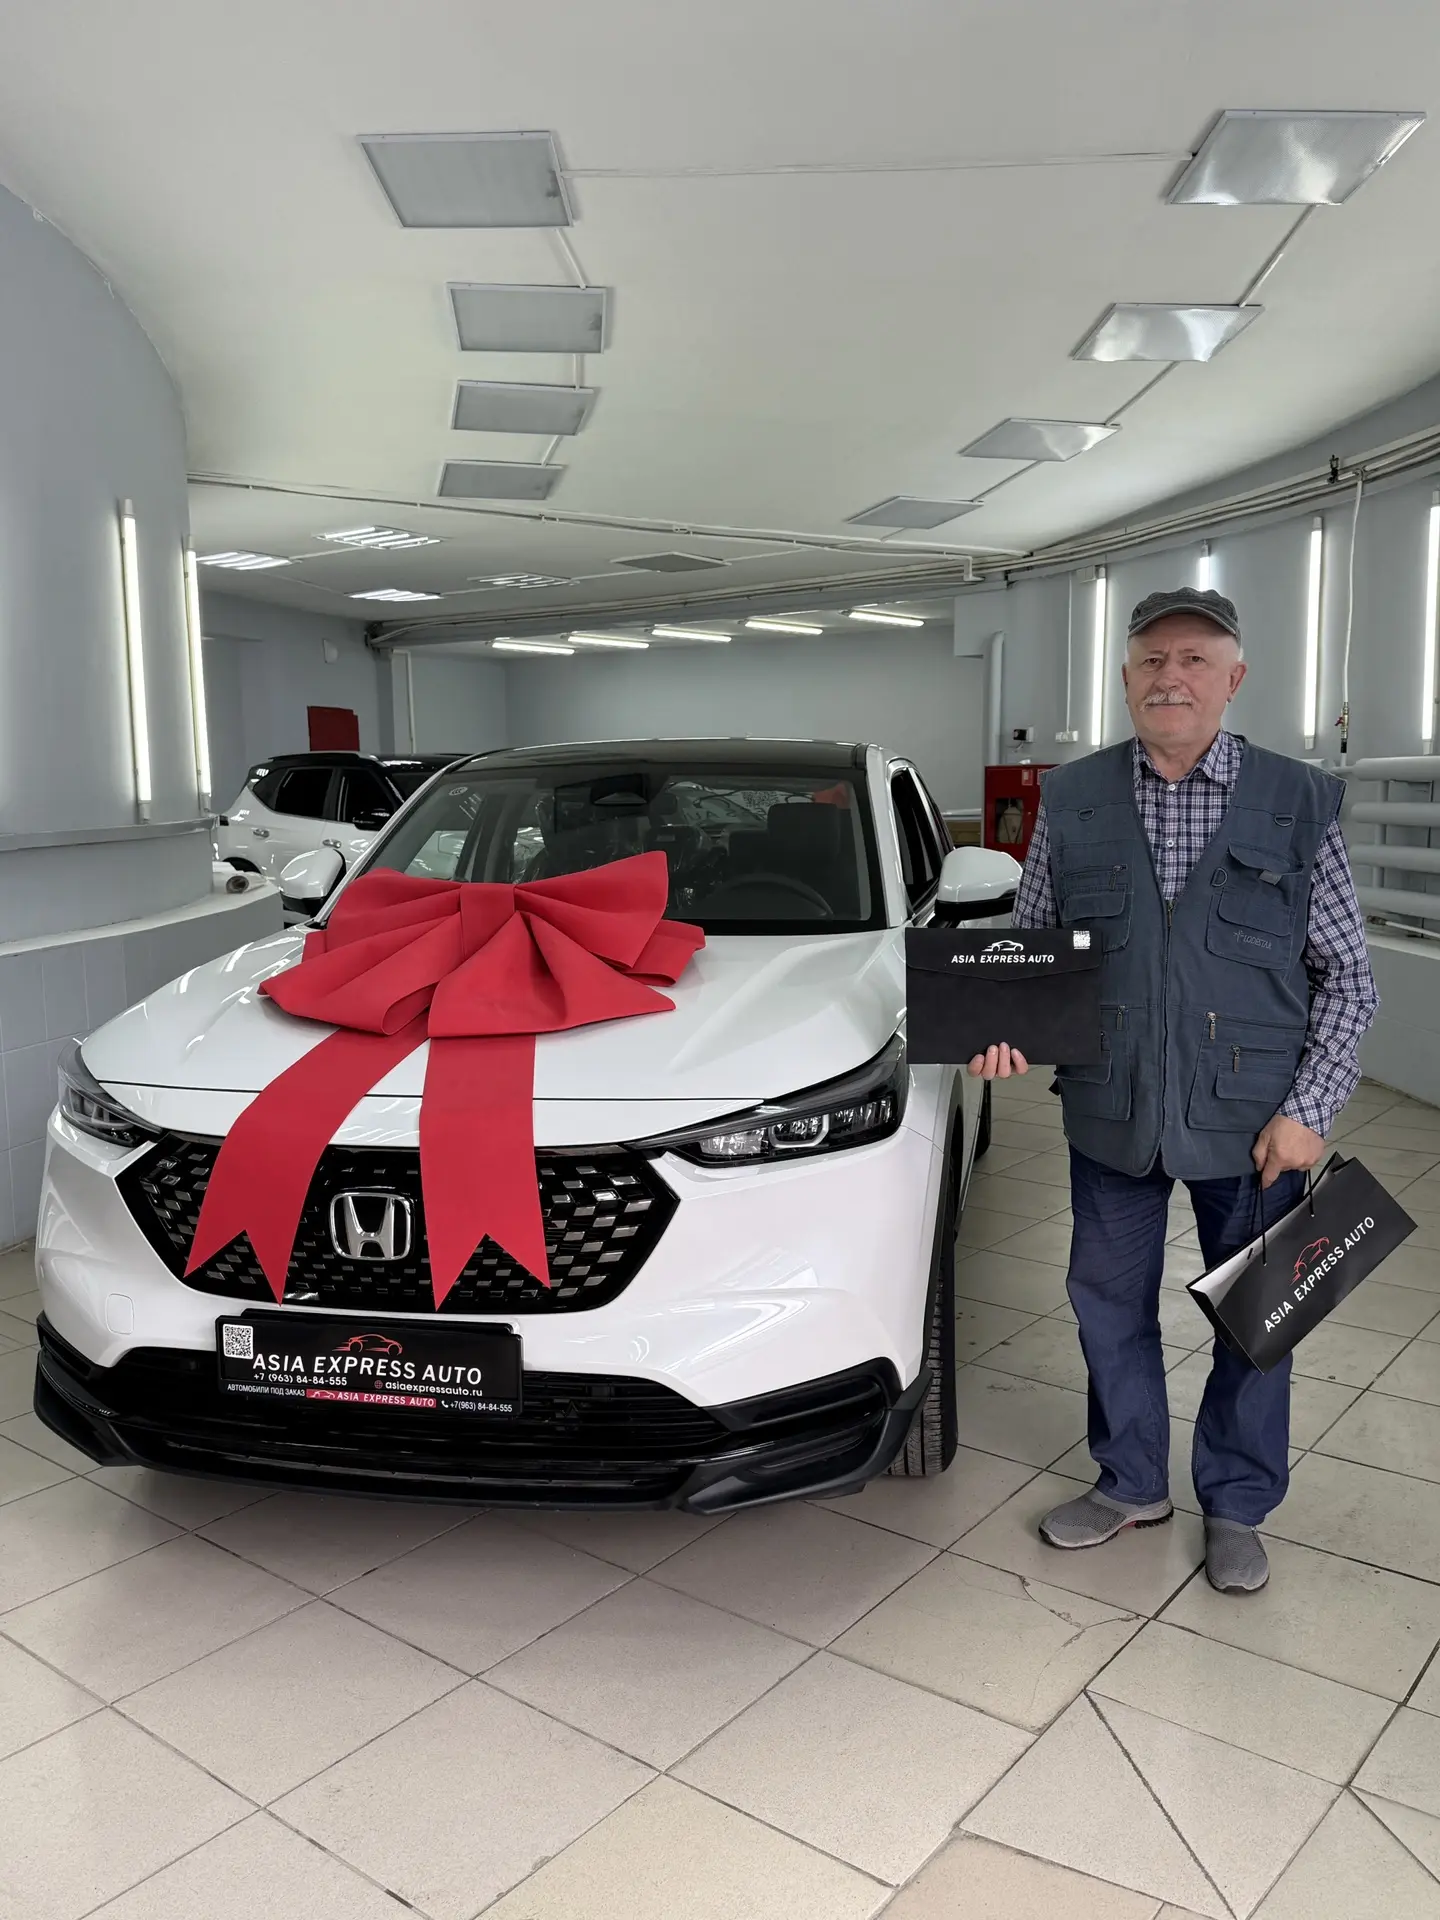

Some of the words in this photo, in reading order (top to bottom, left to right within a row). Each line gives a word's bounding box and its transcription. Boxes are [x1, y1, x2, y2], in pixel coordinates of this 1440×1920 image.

[951, 954, 976, 964] ASIA
[980, 954, 1026, 964] EXPRESS
[1028, 954, 1055, 964] AUTO
[1264, 1301, 1293, 1332] ASIA
[1294, 1247, 1343, 1301] EXPRESS
[1344, 1217, 1375, 1250] AUTO
[253, 1353, 305, 1372] ASIA
[313, 1356, 416, 1379] EXPRESS
[422, 1364, 482, 1385] AUTO
[253, 1372, 265, 1381] +7
[268, 1373, 293, 1383] (963)
[296, 1375, 347, 1386] 84-84-555
[227, 1383, 270, 1394] АВТОМОБИЛИ
[270, 1387, 285, 1396] ПОД
[285, 1388, 306, 1397] ЗАКАЗ
[385, 1381, 483, 1397] asiaexpressauto.ru
[337, 1391, 359, 1402] ASIA
[363, 1393, 406, 1405] EXPRESS
[409, 1398, 435, 1408] AUTO
[450, 1400, 476, 1412] +7(963)
[477, 1402, 513, 1413] 84-84-555
